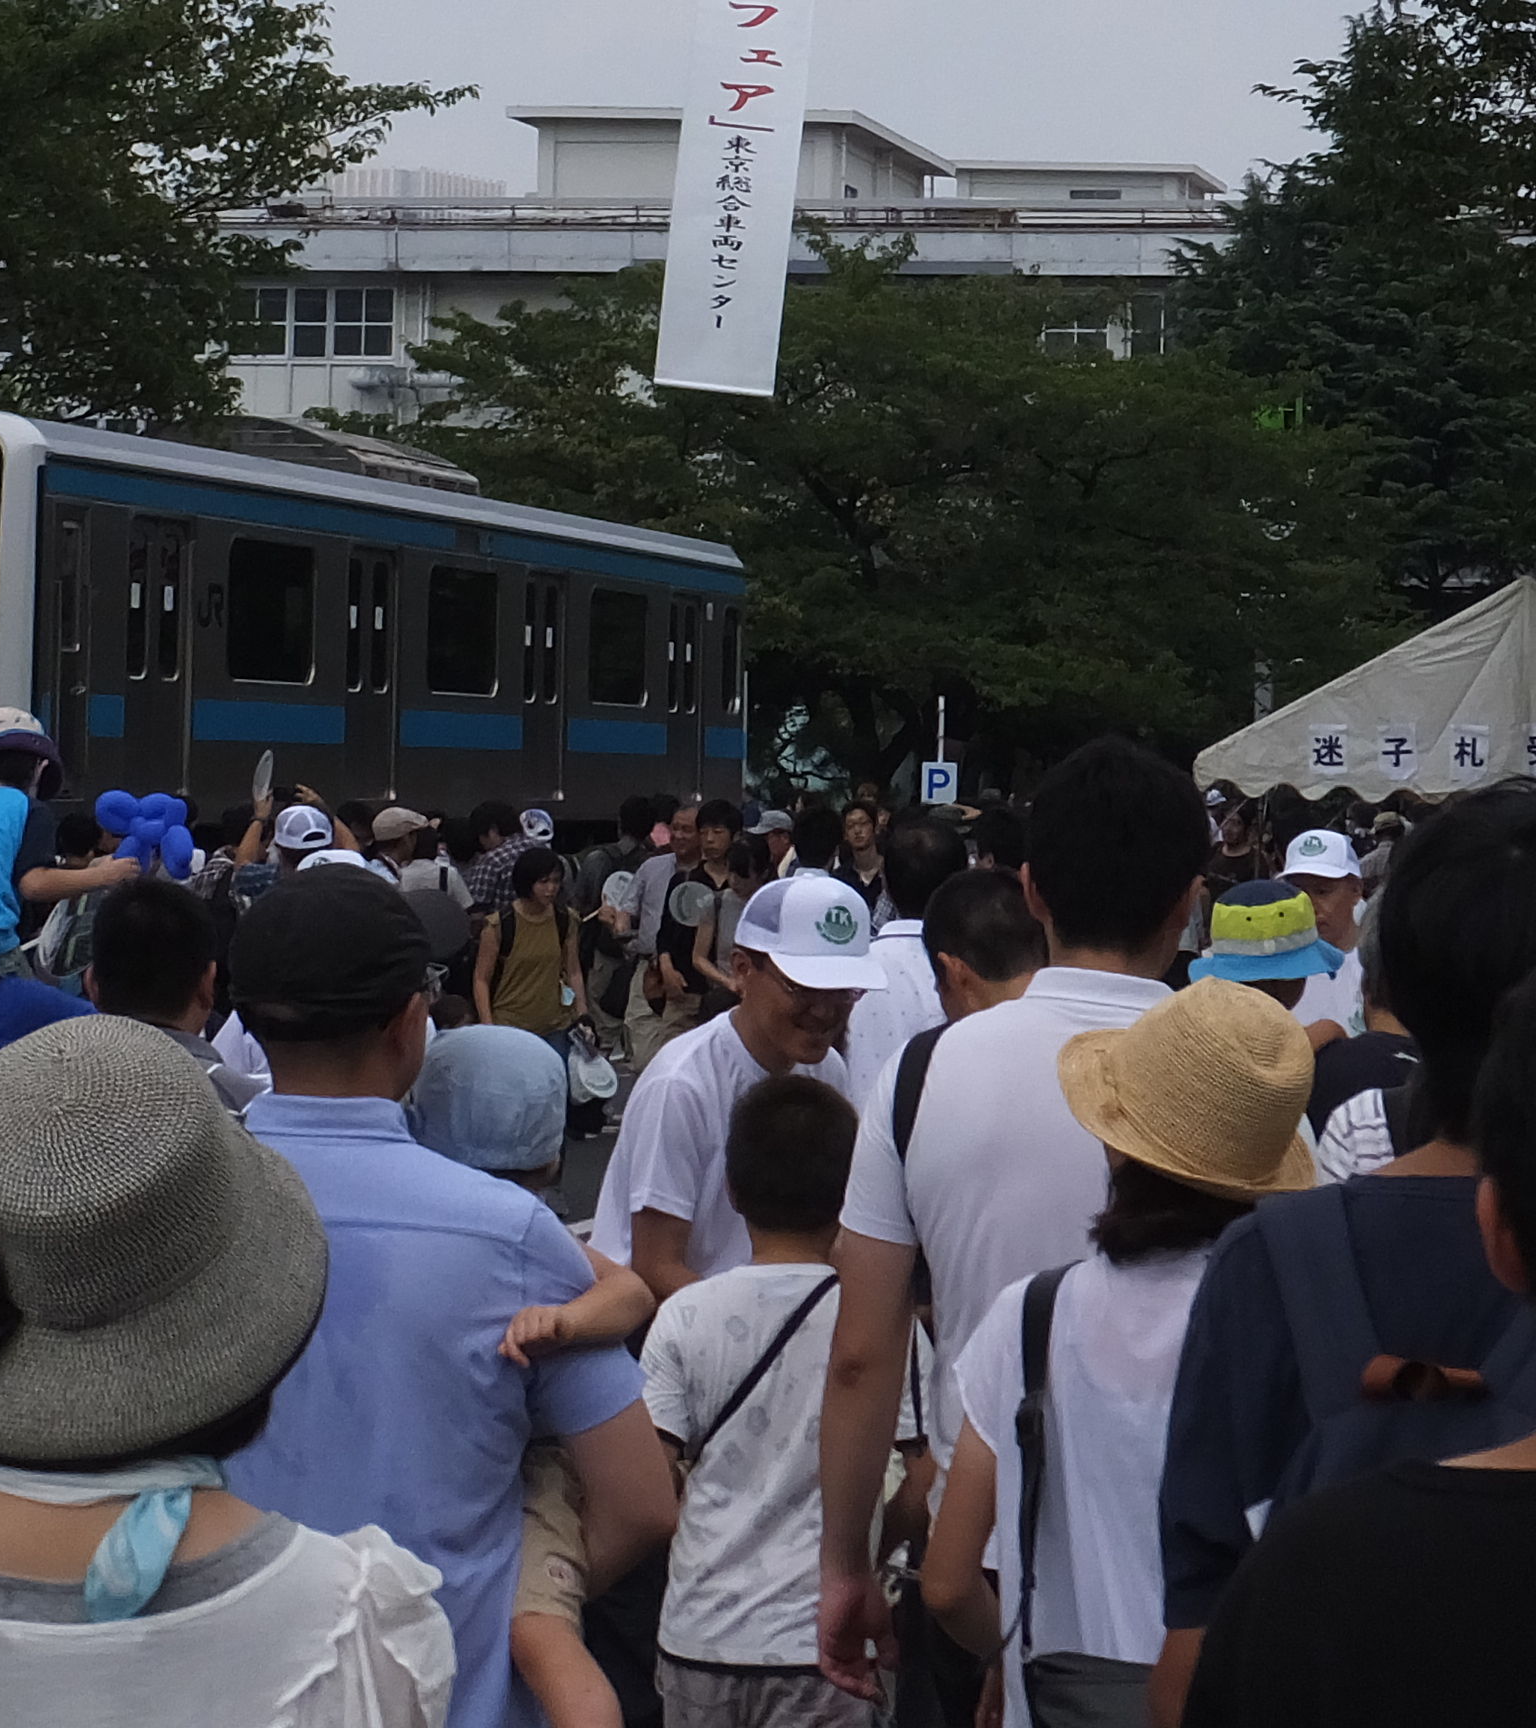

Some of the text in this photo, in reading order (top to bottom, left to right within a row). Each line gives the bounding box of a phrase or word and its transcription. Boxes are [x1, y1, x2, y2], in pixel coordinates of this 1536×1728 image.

[710, 135, 753, 329] 東京総合車両センター
[198, 582, 224, 628] JR
[928, 768, 950, 799] P
